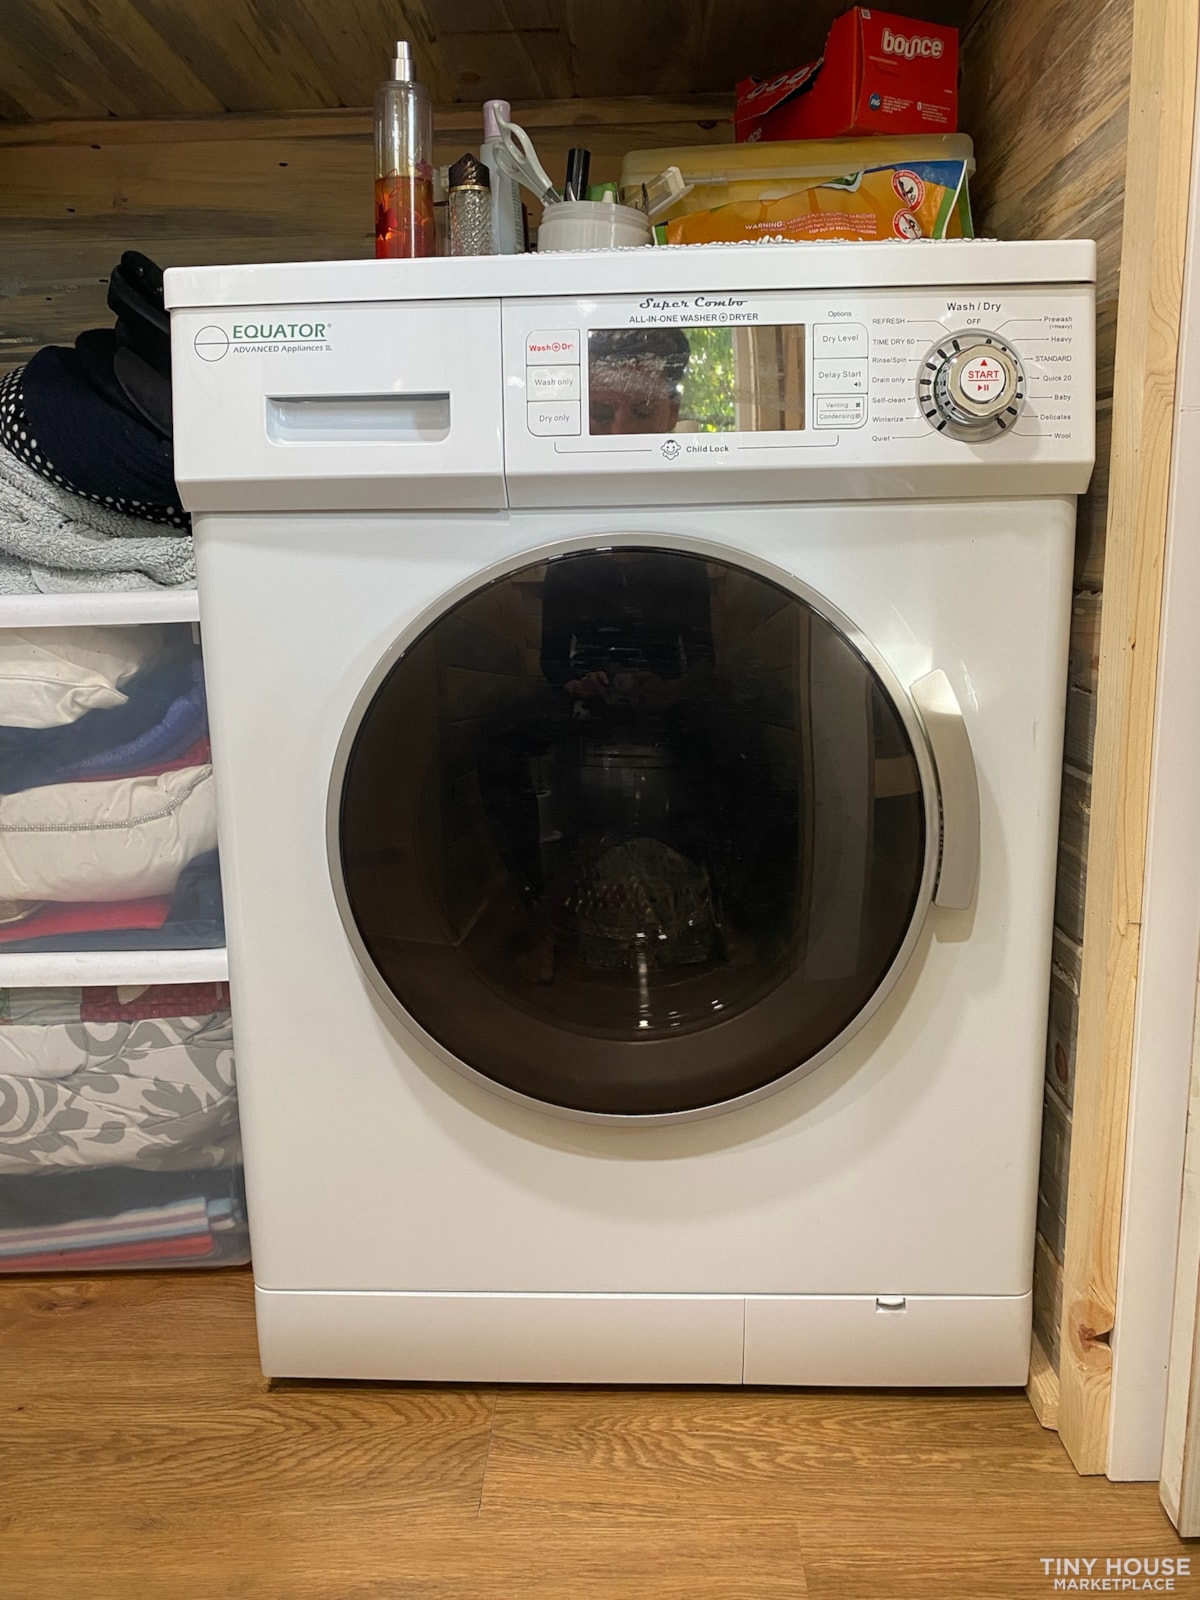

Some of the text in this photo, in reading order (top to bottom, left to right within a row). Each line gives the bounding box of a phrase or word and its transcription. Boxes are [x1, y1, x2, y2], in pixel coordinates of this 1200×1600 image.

[882, 28, 944, 59] bounce
[744, 220, 786, 230] WARNING:
[639, 296, 748, 310] Super Combo
[946, 302, 975, 311] Wash
[983, 302, 1002, 312] Dry
[629, 313, 759, 323] ALL-IN-ONE WASHER DRYER
[232, 323, 326, 339] EQUATOR
[822, 334, 859, 343] Dry Level
[233, 345, 280, 353] ADVANCED
[281, 344, 324, 354] Appliances
[529, 344, 552, 352] Wash
[818, 370, 862, 379] Delay Start
[968, 370, 999, 379] START
[557, 378, 574, 386] only
[539, 414, 570, 423] Dry only
[686, 444, 729, 453] Child Lock
